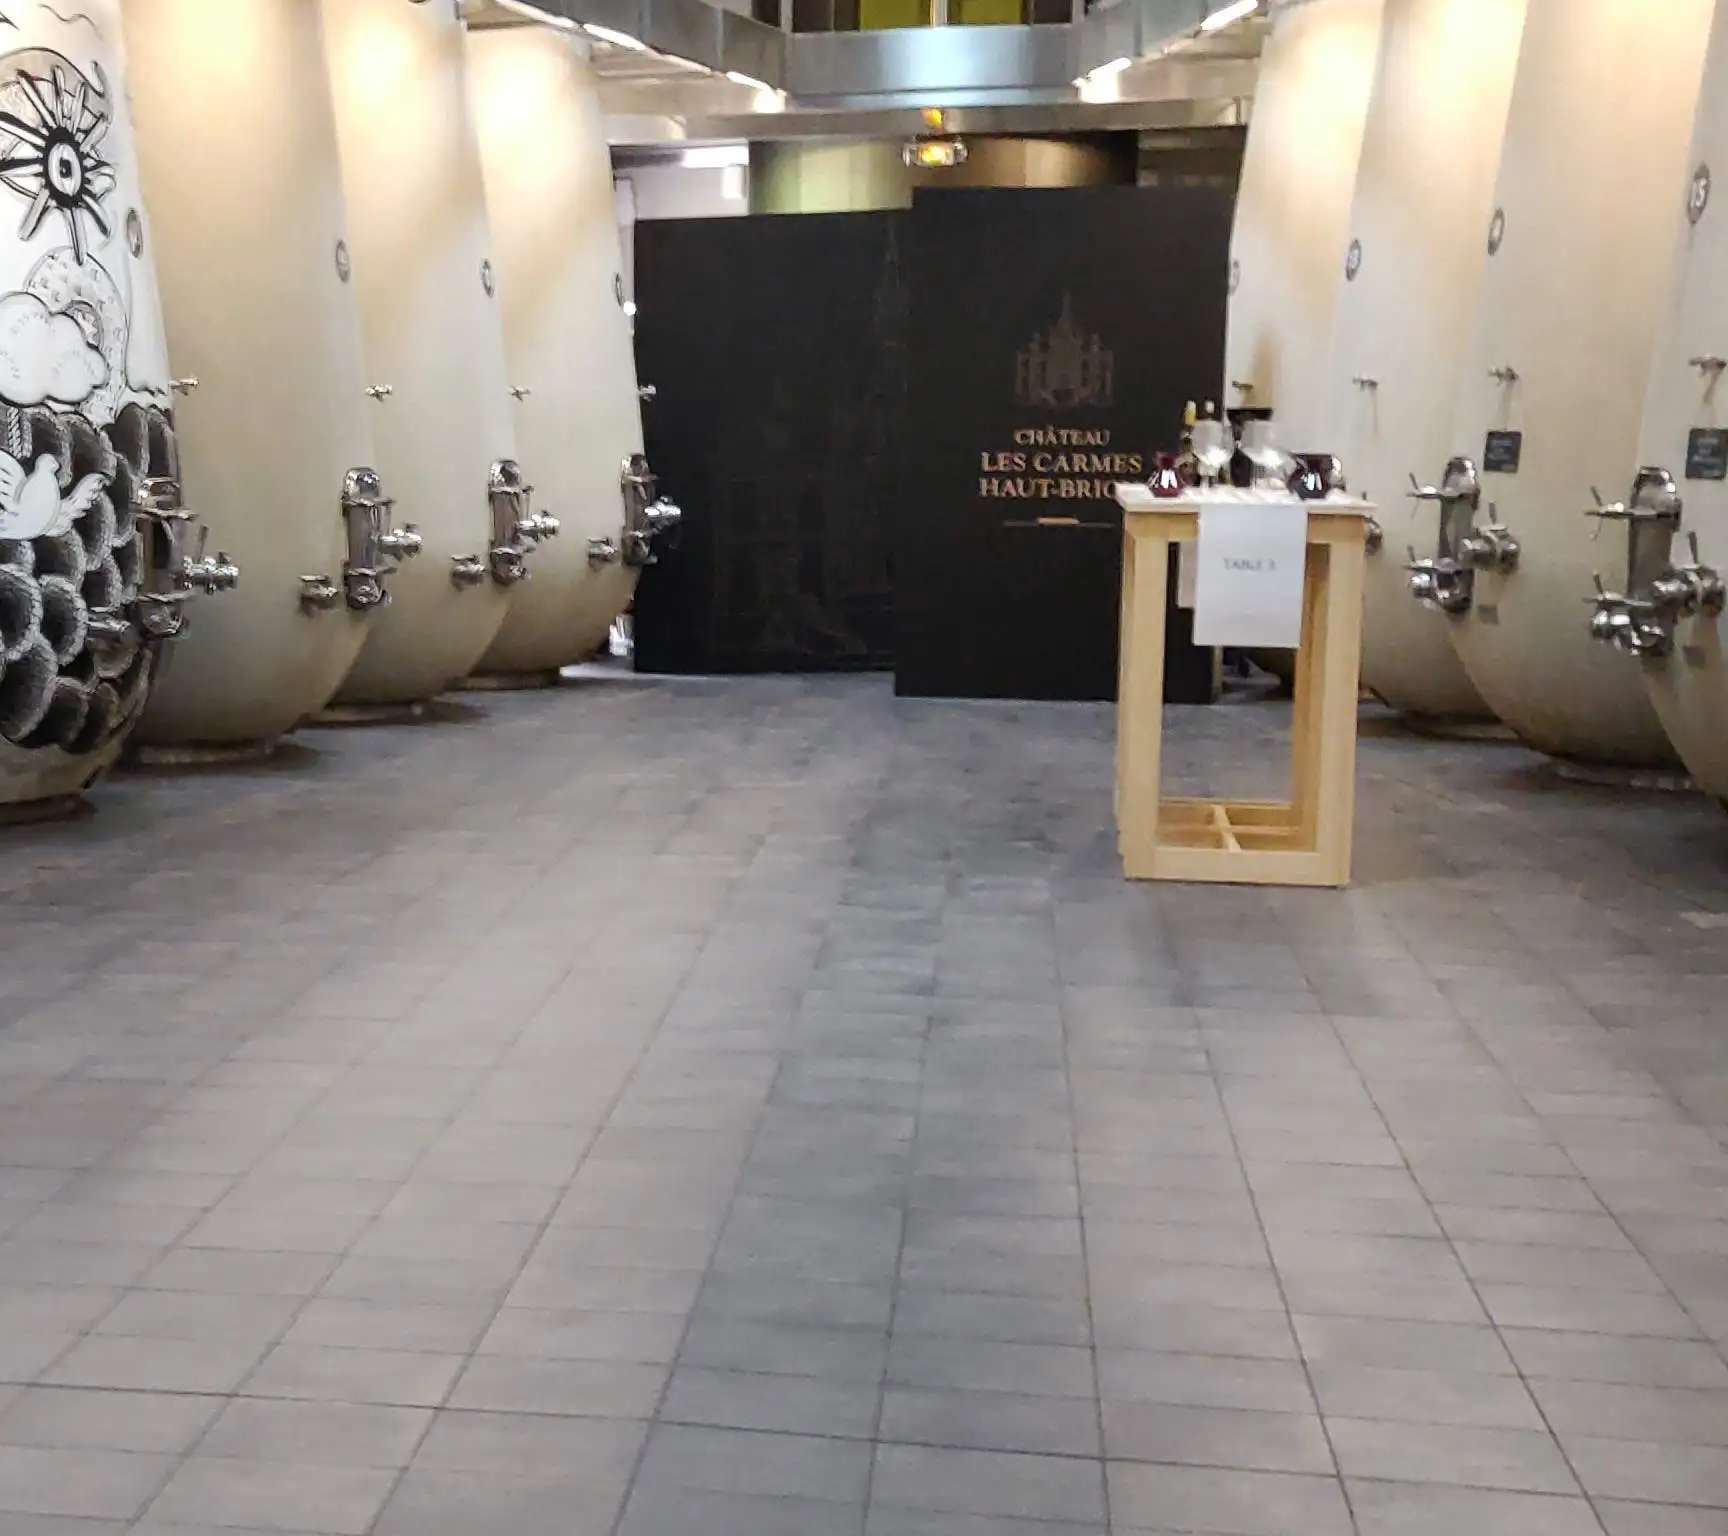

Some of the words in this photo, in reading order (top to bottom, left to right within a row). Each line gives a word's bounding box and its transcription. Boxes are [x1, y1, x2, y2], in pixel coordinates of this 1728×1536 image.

[1013, 424, 1111, 446] CHÂTEAU
[981, 451, 1026, 473] LES
[1032, 451, 1143, 474] CARMES
[979, 476, 1120, 499] HAUT-BRIO
